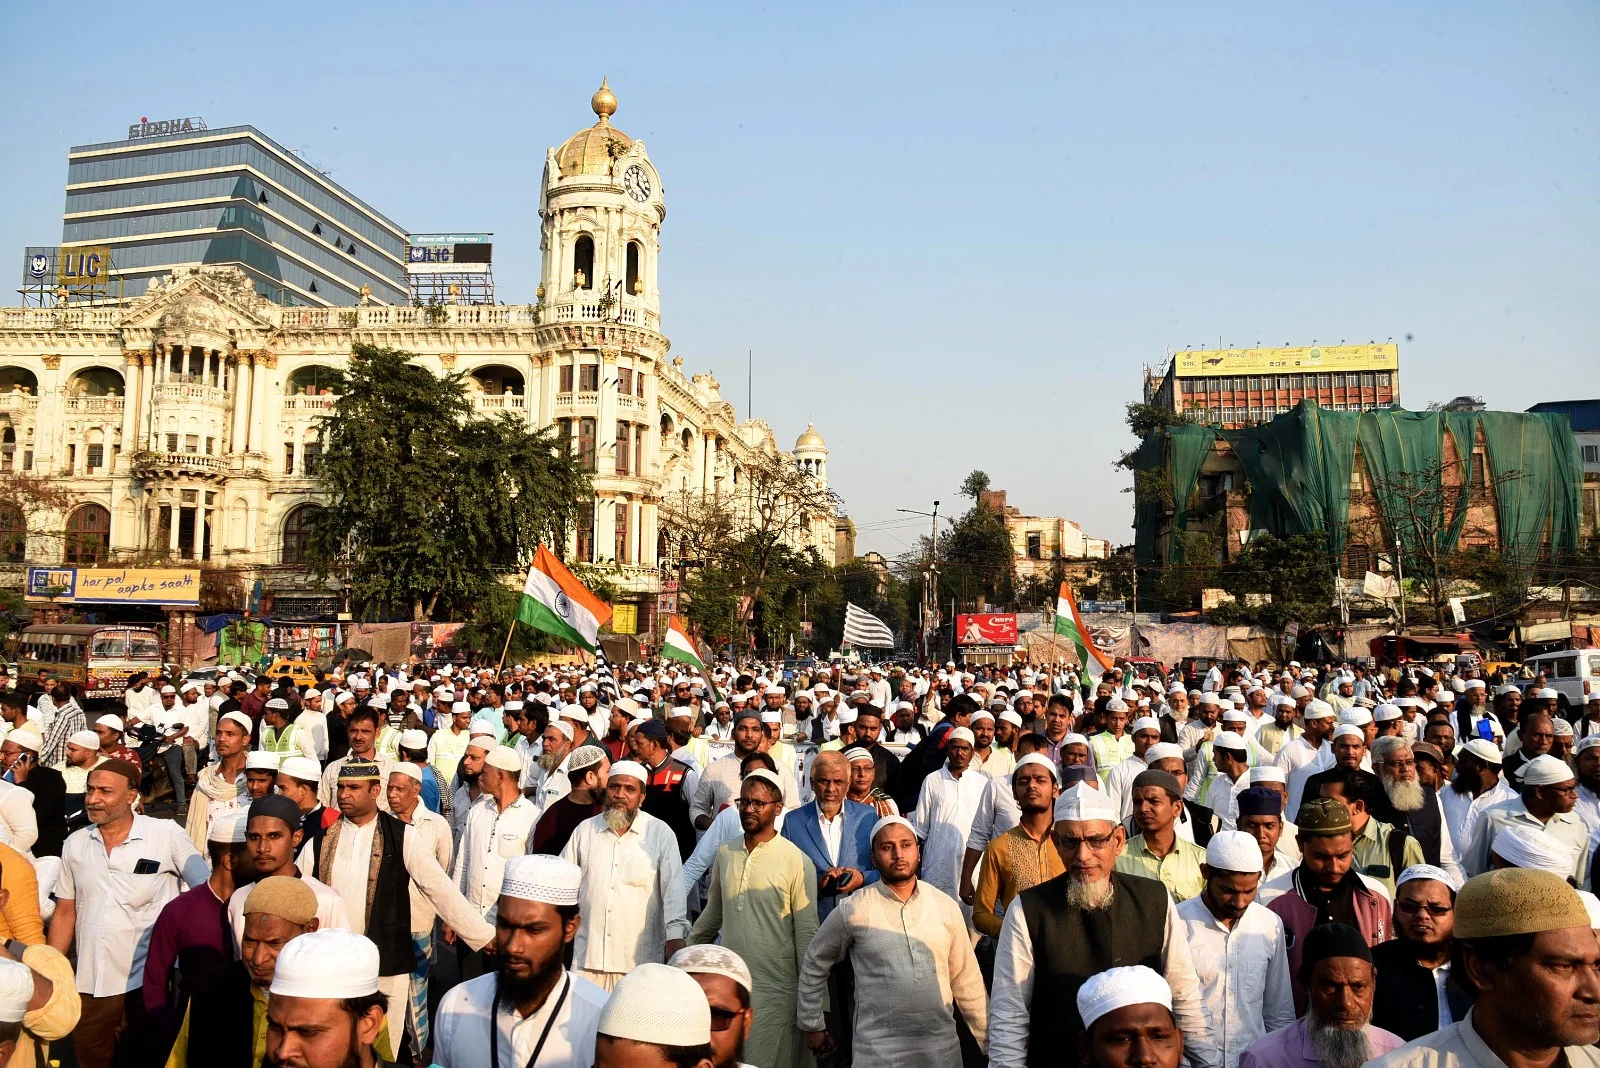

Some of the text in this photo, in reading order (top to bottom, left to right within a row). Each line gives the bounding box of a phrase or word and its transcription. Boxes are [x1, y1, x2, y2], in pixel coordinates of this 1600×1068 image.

[128, 117, 193, 139] SIDDHA
[66, 253, 101, 277] LIC
[427, 247, 450, 262] LIC
[50, 573, 69, 586] LIC
[82, 570, 126, 590] har pal
[117, 573, 193, 597] aapke saath
